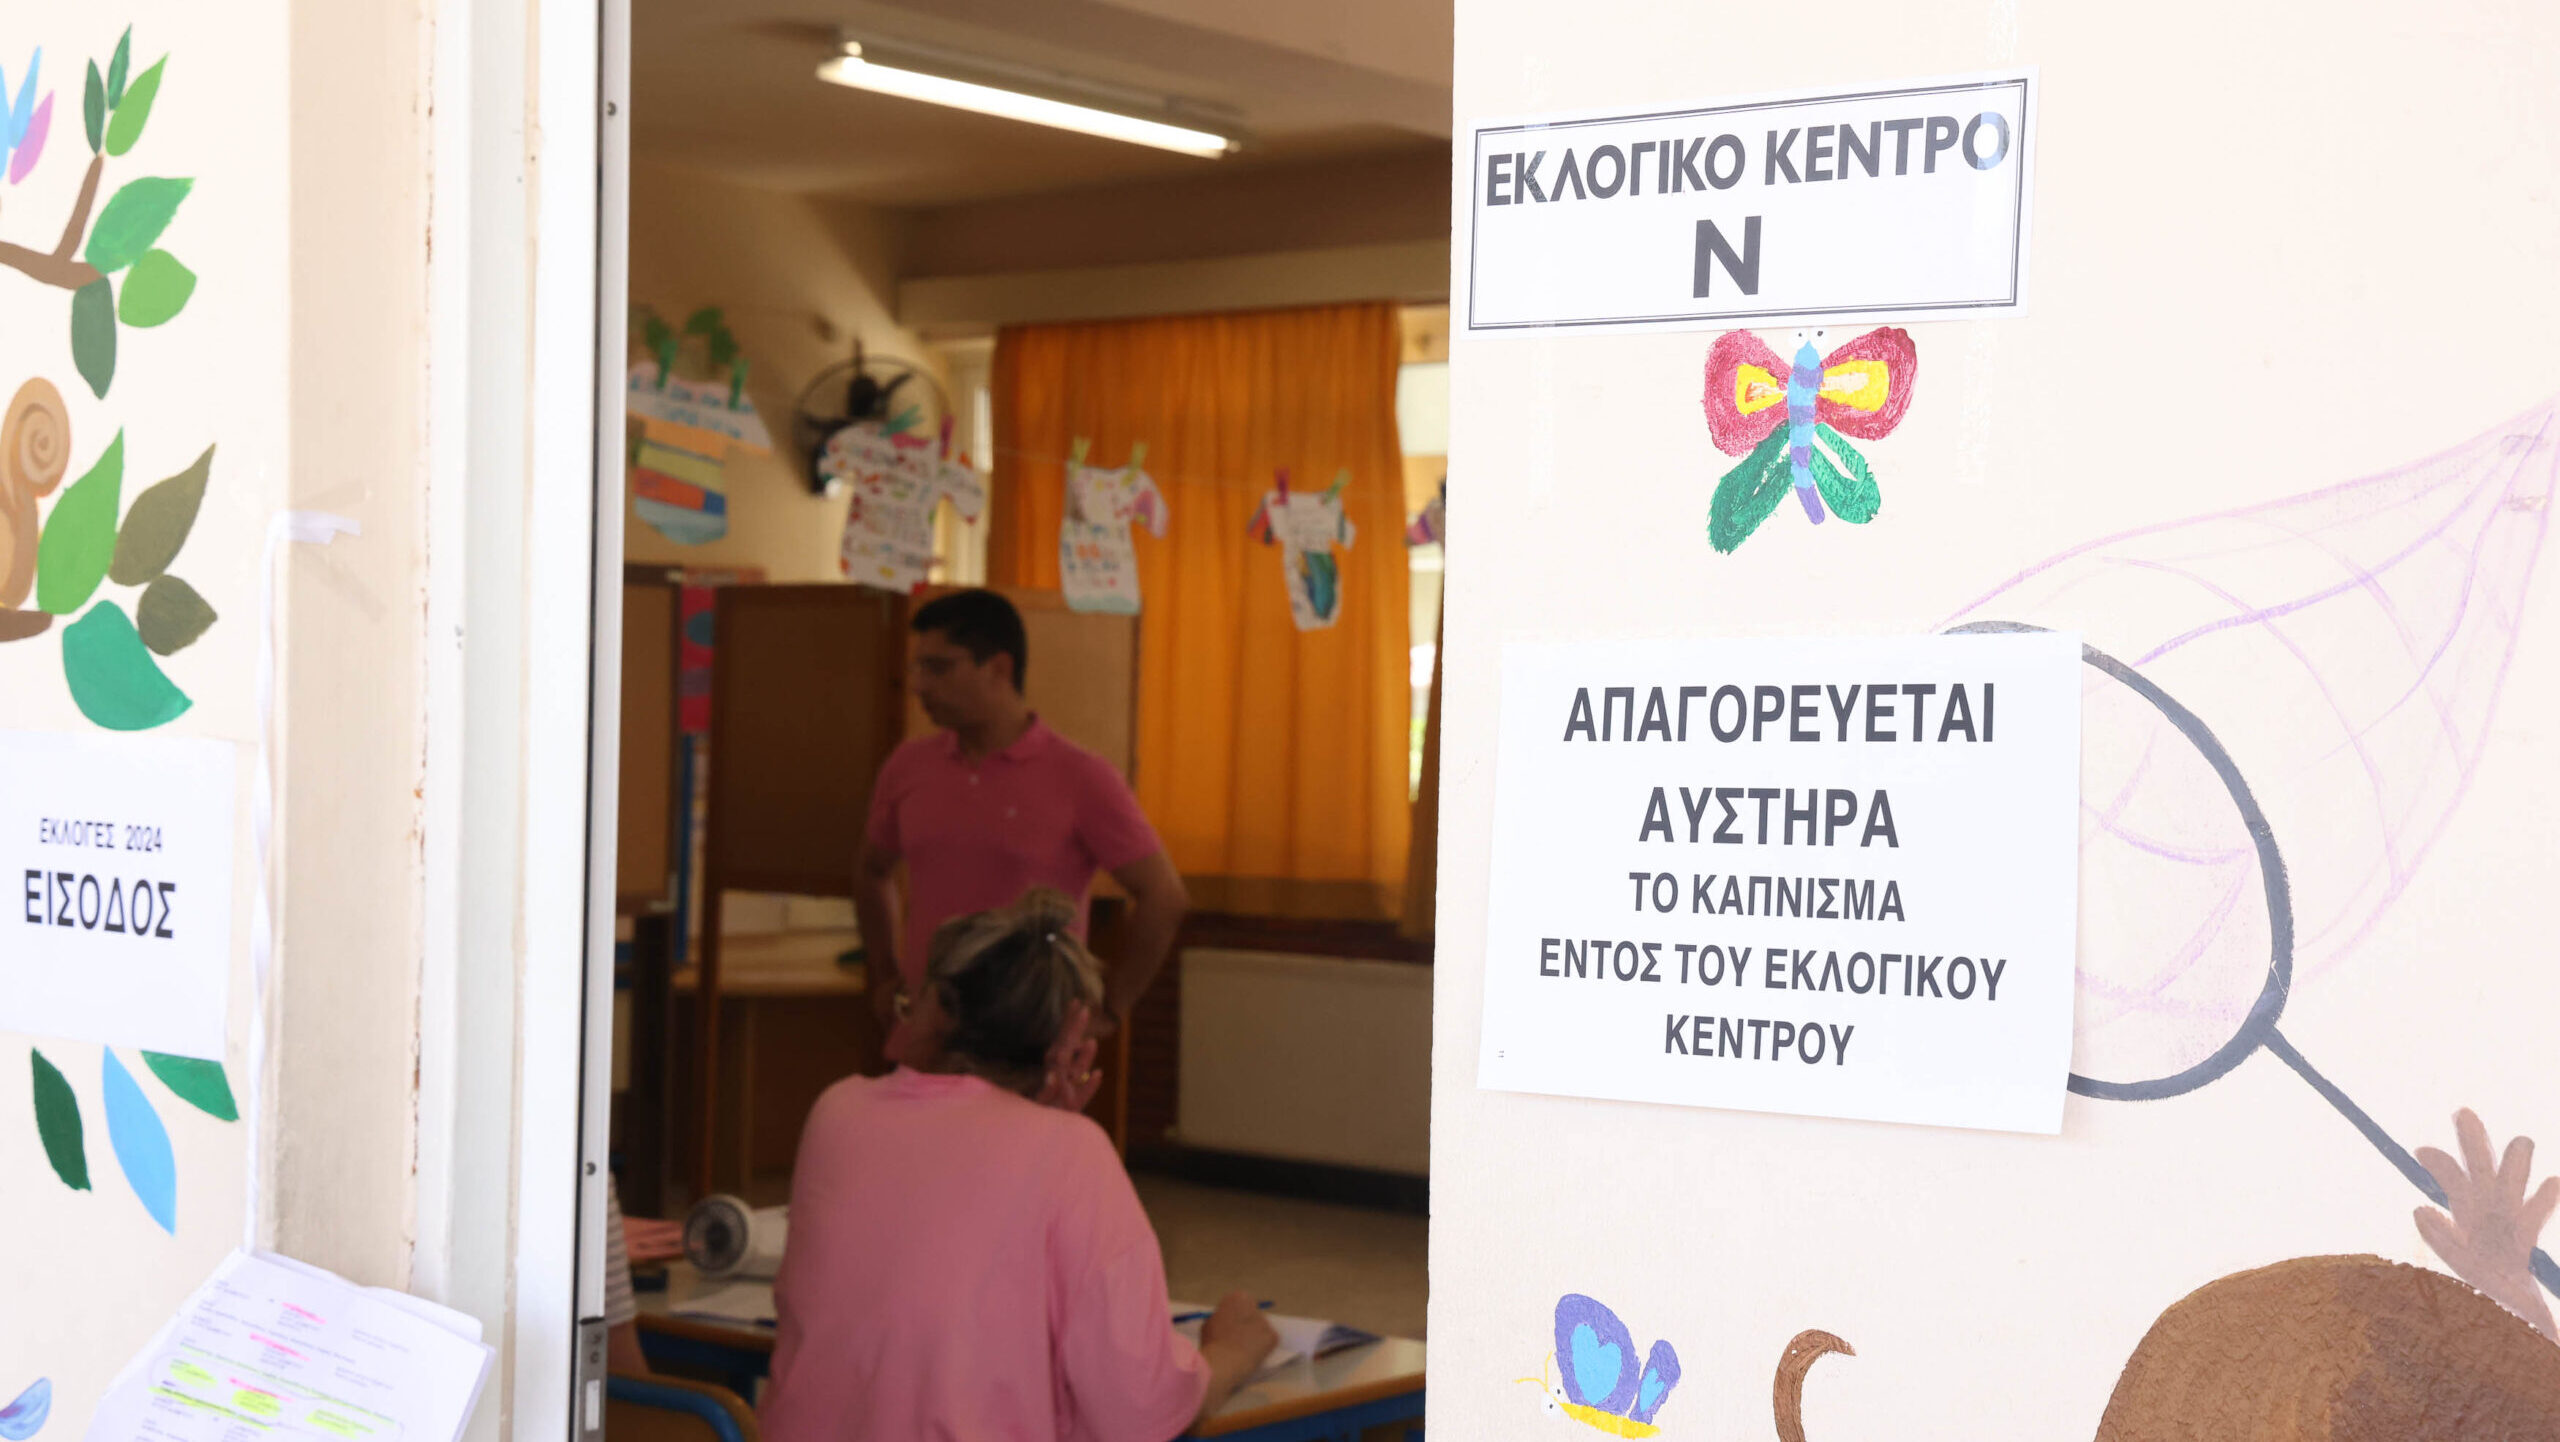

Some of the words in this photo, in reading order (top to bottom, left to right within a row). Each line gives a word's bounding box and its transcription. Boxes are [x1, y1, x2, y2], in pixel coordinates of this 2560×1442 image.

[1486, 134, 1745, 206] ΕΚΛΟΓΙΚΟ
[1764, 111, 2010, 186] ΚΕΝΤΡΟ
[1693, 215, 1762, 299] Ν
[1563, 683, 1994, 744] ΑΠΑΓΟΡΕΥΕΤΑΙ
[40, 817, 115, 849] ΕΚΛΟΓΕΣ
[125, 824, 163, 852] 2024
[1638, 786, 1900, 848] ΑΥΣΤΗΡΑ
[25, 869, 176, 939] ΕΙΣΟΔΟΣ
[1628, 871, 1679, 914] ΤΟ
[1692, 873, 1906, 922] ΚΑΠΝΙΣΜΑ
[1540, 938, 1662, 983] ΕΝΤΟΣ
[1674, 943, 1753, 987] ΤΟΥ
[1765, 948, 2007, 1001] ΕΚΛΟΓΙΚΟΥ
[1665, 1013, 1855, 1066] ΚΕΝΤΡΟΥ
